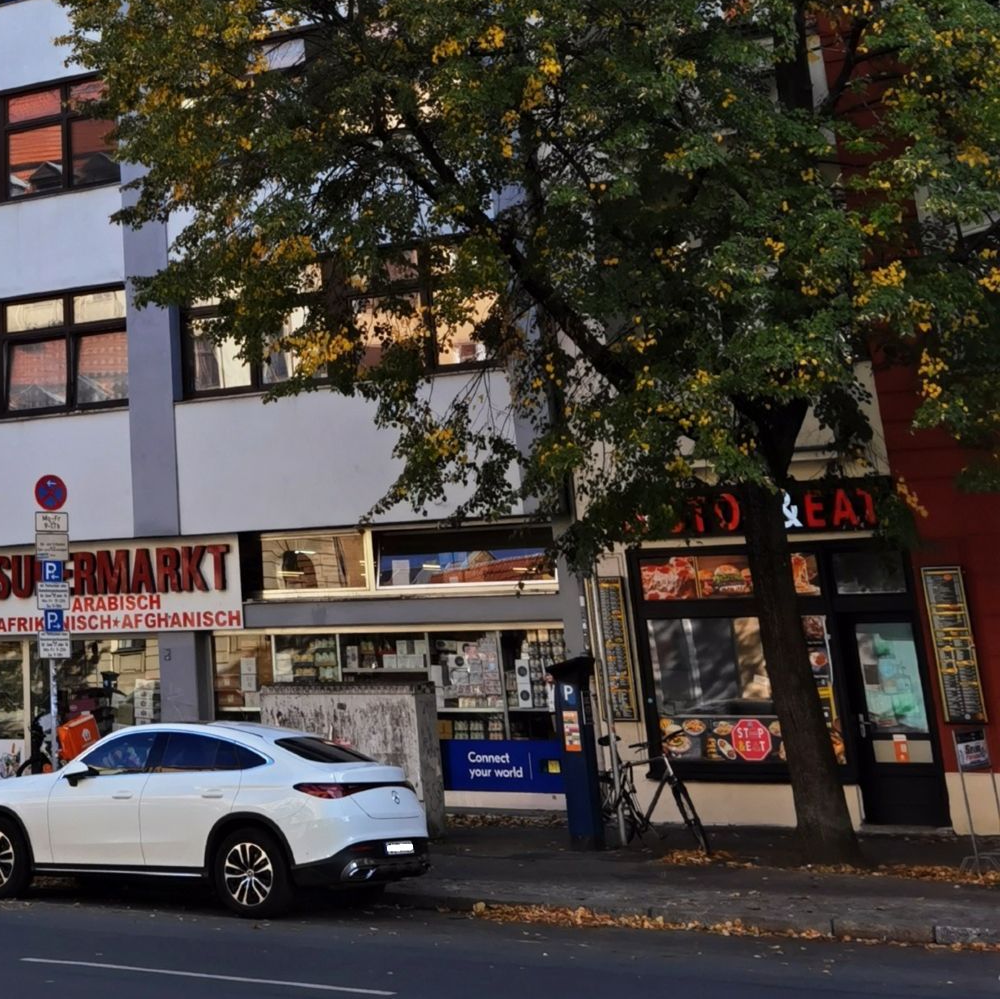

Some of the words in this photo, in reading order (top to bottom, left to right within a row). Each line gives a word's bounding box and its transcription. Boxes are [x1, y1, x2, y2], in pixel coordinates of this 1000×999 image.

[45, 562, 57, 580] P
[72, 594, 161, 613] ARABISCH
[47, 612, 58, 630] P
[121, 610, 241, 630] AFGHANISCH
[563, 684, 574, 701] P
[736, 727, 765, 739] STP
[745, 740, 766, 752] ET
[467, 751, 510, 764] Connect
[469, 768, 492, 780] your
[495, 766, 524, 779] world
